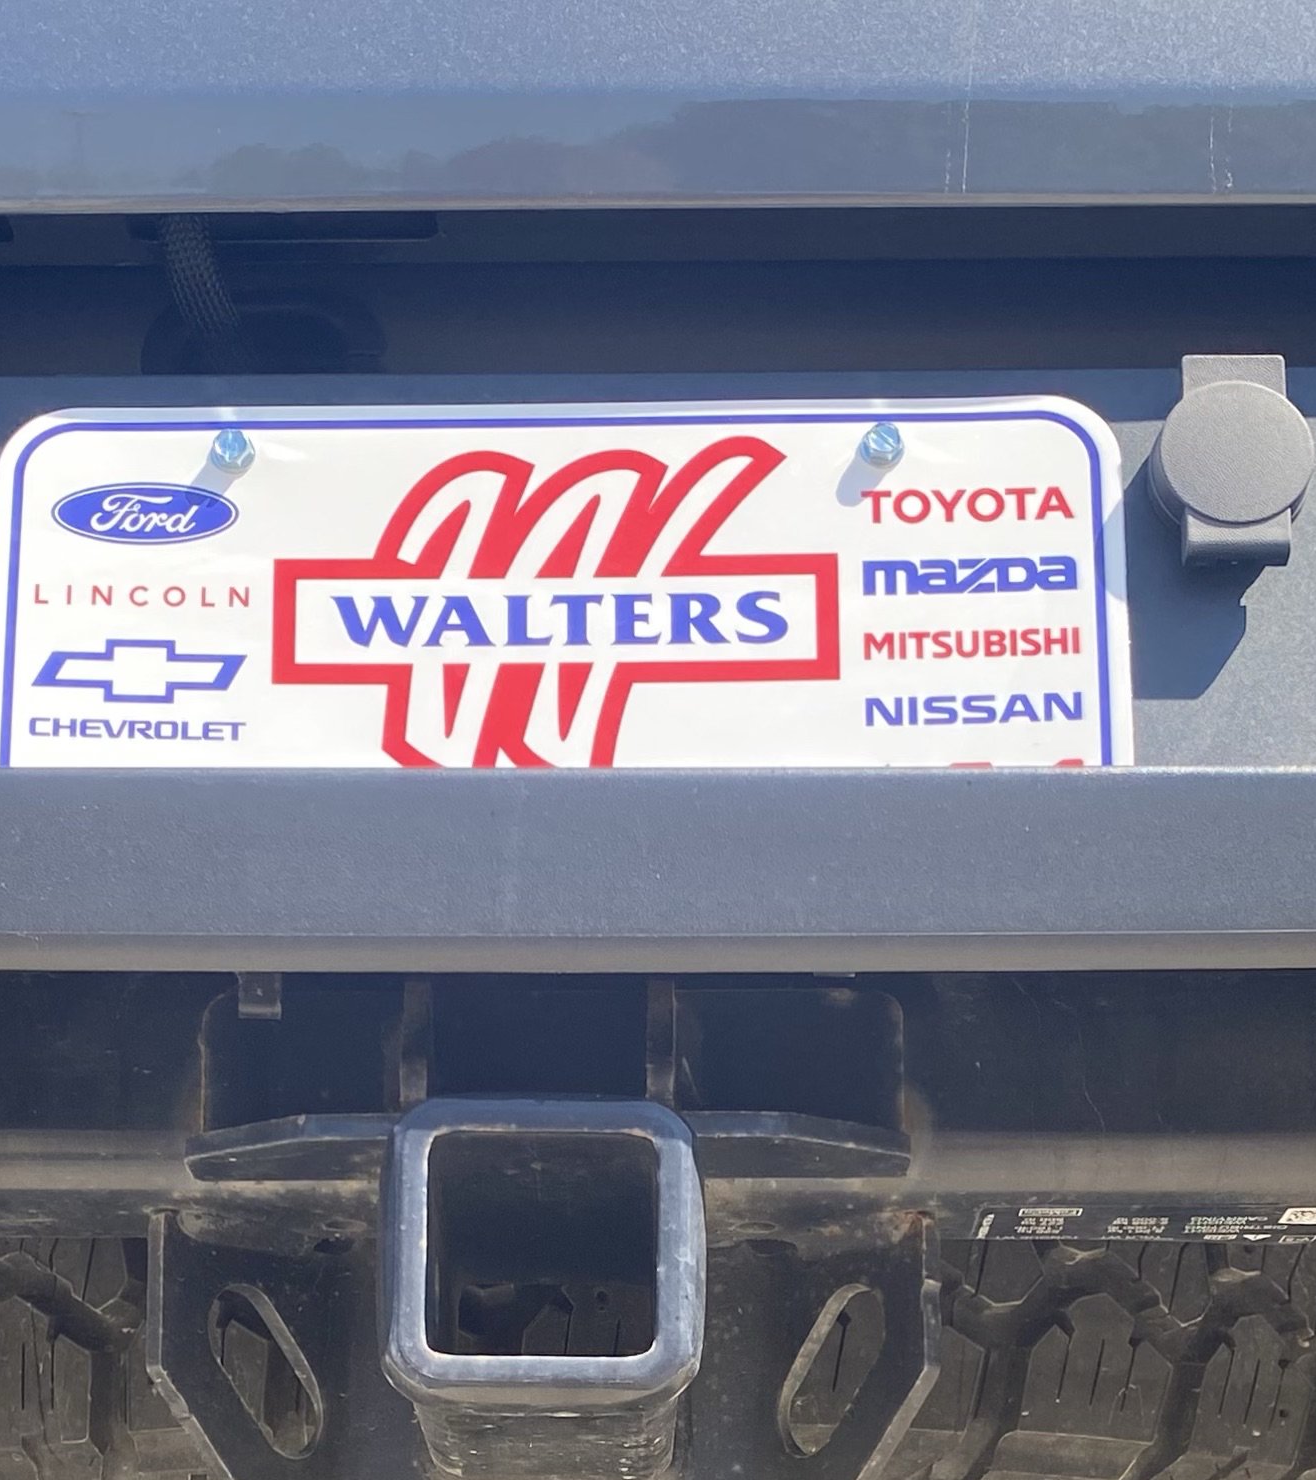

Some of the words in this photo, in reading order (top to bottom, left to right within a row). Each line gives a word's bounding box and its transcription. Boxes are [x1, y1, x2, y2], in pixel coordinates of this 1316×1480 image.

[89, 492, 200, 534] Ford
[860, 486, 1075, 524] TOYOTA
[33, 583, 251, 608] LINCOLN
[330, 590, 789, 649] WALTERS
[862, 626, 1082, 661] MITSUBISHI
[864, 691, 1084, 727] NISSAN
[29, 716, 247, 741] CHEVROLET
